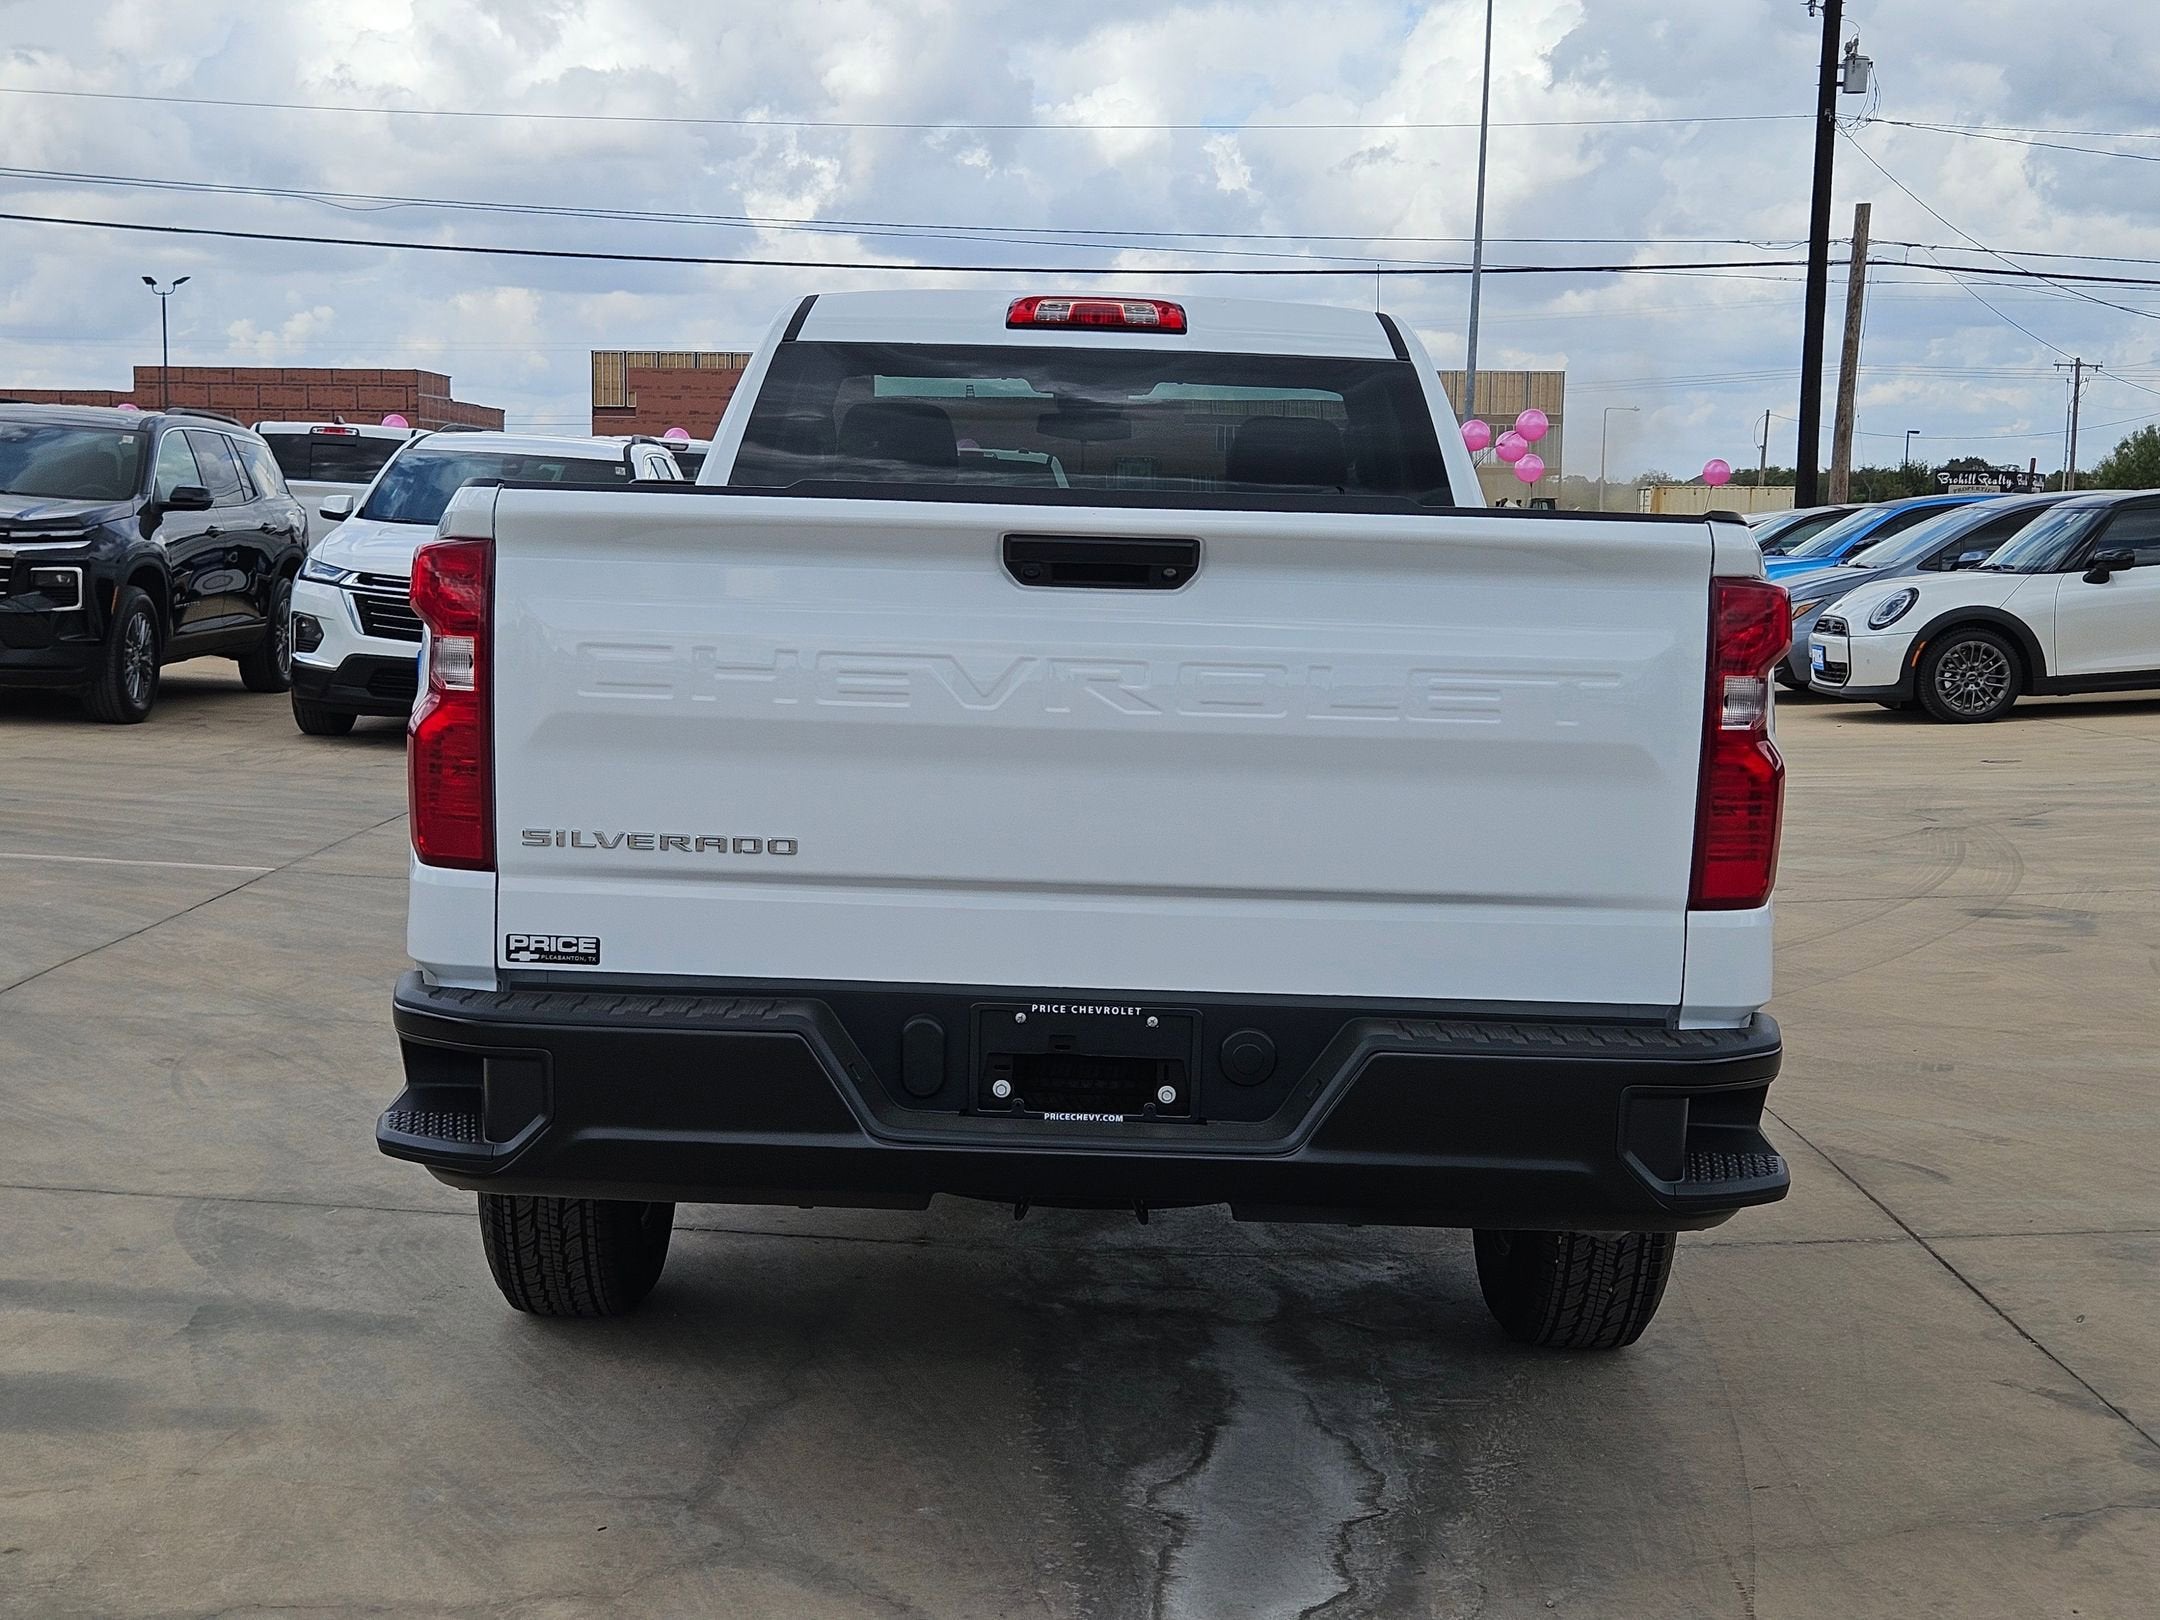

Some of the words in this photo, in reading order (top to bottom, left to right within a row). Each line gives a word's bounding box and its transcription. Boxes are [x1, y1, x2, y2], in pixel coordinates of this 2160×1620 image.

[576, 641, 1623, 726] CHEVROLET
[521, 827, 799, 856] SILVERADO
[509, 935, 597, 953] PRICE
[1031, 1004, 1066, 1013] PRICE
[1071, 1005, 1142, 1015] CHEVROLET
[1044, 1112, 1124, 1122] PRICECHEVY.COM
